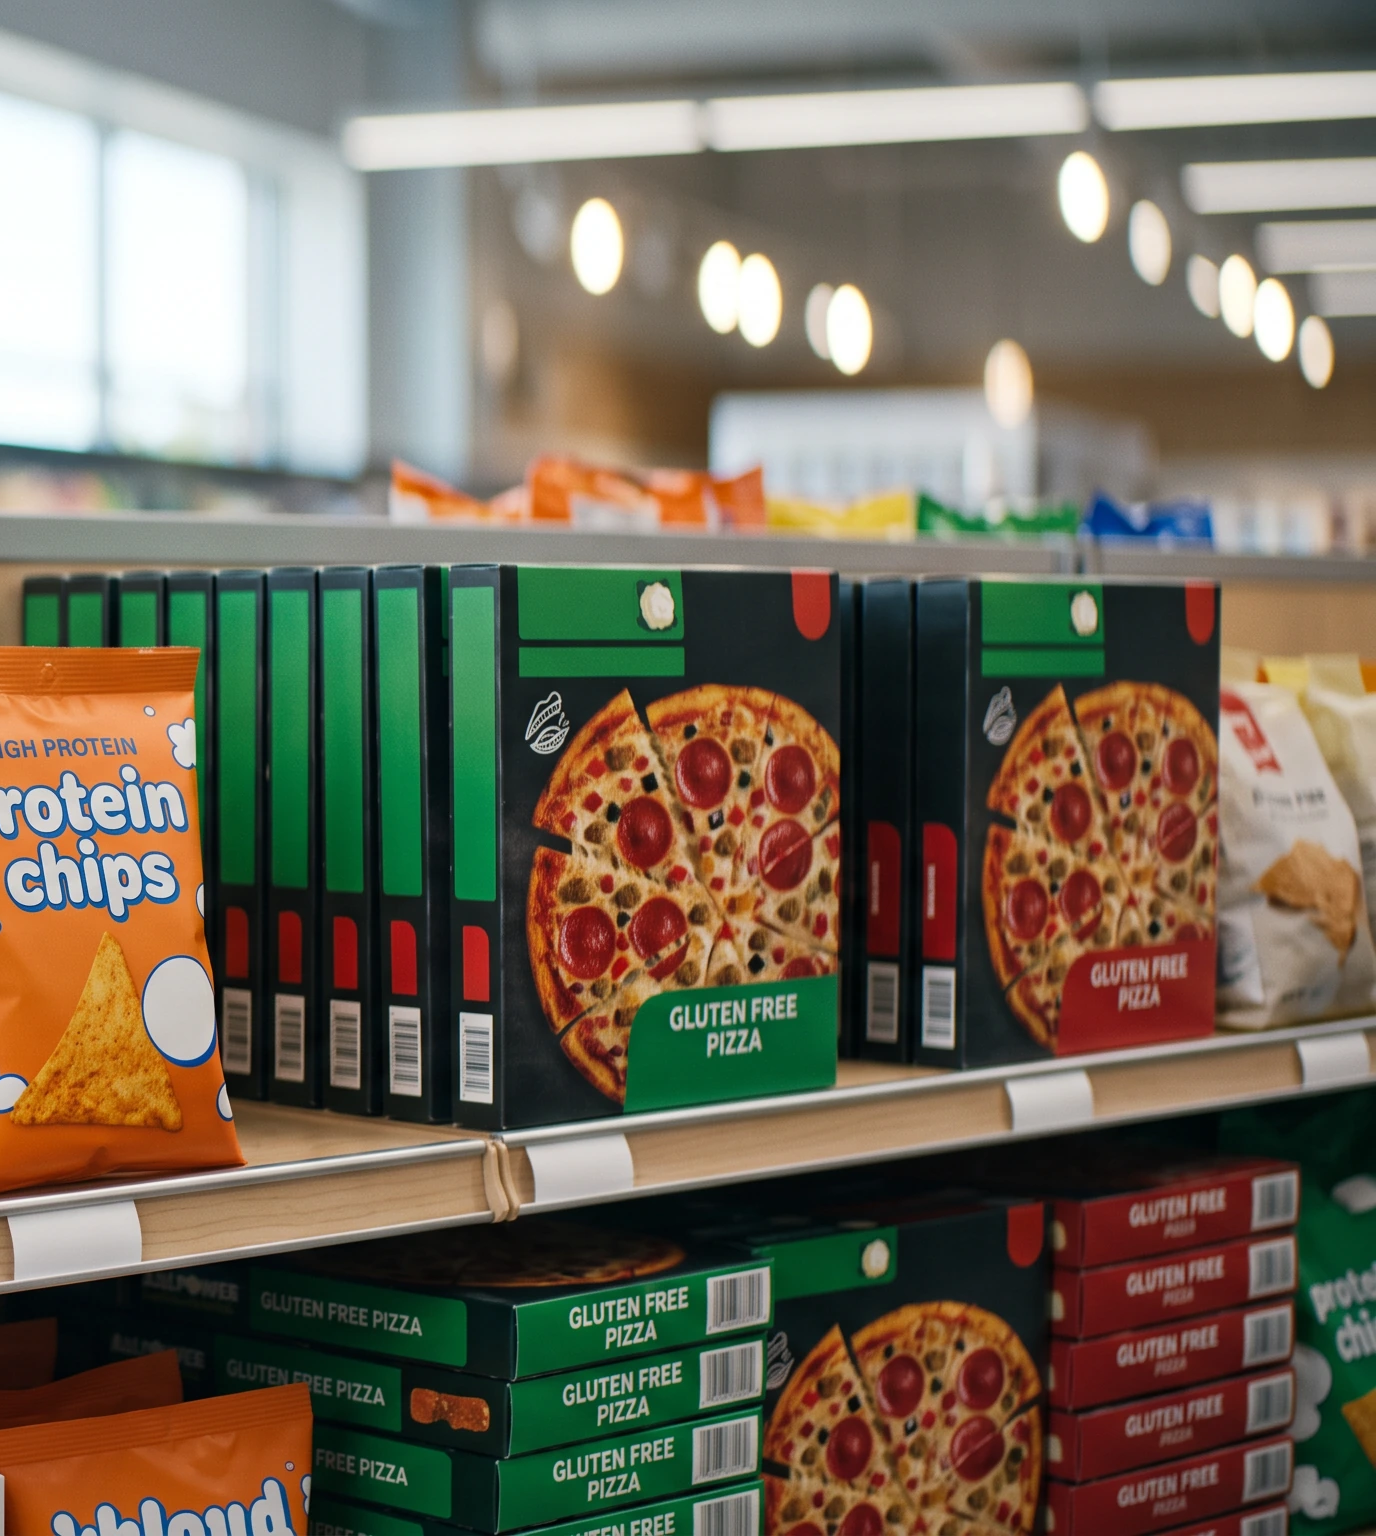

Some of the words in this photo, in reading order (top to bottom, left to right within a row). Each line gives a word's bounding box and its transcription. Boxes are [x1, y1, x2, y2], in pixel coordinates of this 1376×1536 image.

[43, 737, 138, 757] PROTEIN
[5, 838, 178, 920] chips
[1090, 957, 1150, 988] GLUTEN
[1152, 952, 1188, 982] FREE
[669, 998, 746, 1031] GLUTEN
[751, 993, 797, 1022] FREE
[1117, 982, 1161, 1012] PIZZA
[706, 1028, 762, 1058] PIZZA
[1128, 1194, 1188, 1228] GLUTEN
[1190, 1186, 1227, 1215] FREE
[1126, 1263, 1186, 1297] GLUTEN
[1188, 1254, 1225, 1283] FREE
[260, 1290, 324, 1319] GLUTEN
[328, 1302, 369, 1327] FREE
[372, 1310, 423, 1337] PIZZA
[569, 1295, 641, 1330] GLUTEN
[645, 1286, 689, 1315] FREE
[605, 1319, 657, 1350] PIZZA
[1116, 1333, 1177, 1367] GLUTEN
[1180, 1324, 1219, 1353] FREE
[226, 1358, 290, 1386] GLUTEN
[336, 1379, 386, 1407] PIZZA
[562, 1370, 634, 1407] GLUTEN
[638, 1361, 683, 1391] FREE
[596, 1396, 650, 1427] PIZZA
[1125, 1403, 1184, 1437] GLUTEN
[1187, 1393, 1224, 1423] FREE
[315, 1448, 356, 1475] FREE
[359, 1457, 409, 1487] PIZZA
[552, 1447, 625, 1483] GLUTEN
[630, 1436, 675, 1466] FREE
[587, 1471, 642, 1502] PIZZA
[1117, 1472, 1177, 1508] GLUTEN
[1180, 1463, 1220, 1492] FREE
